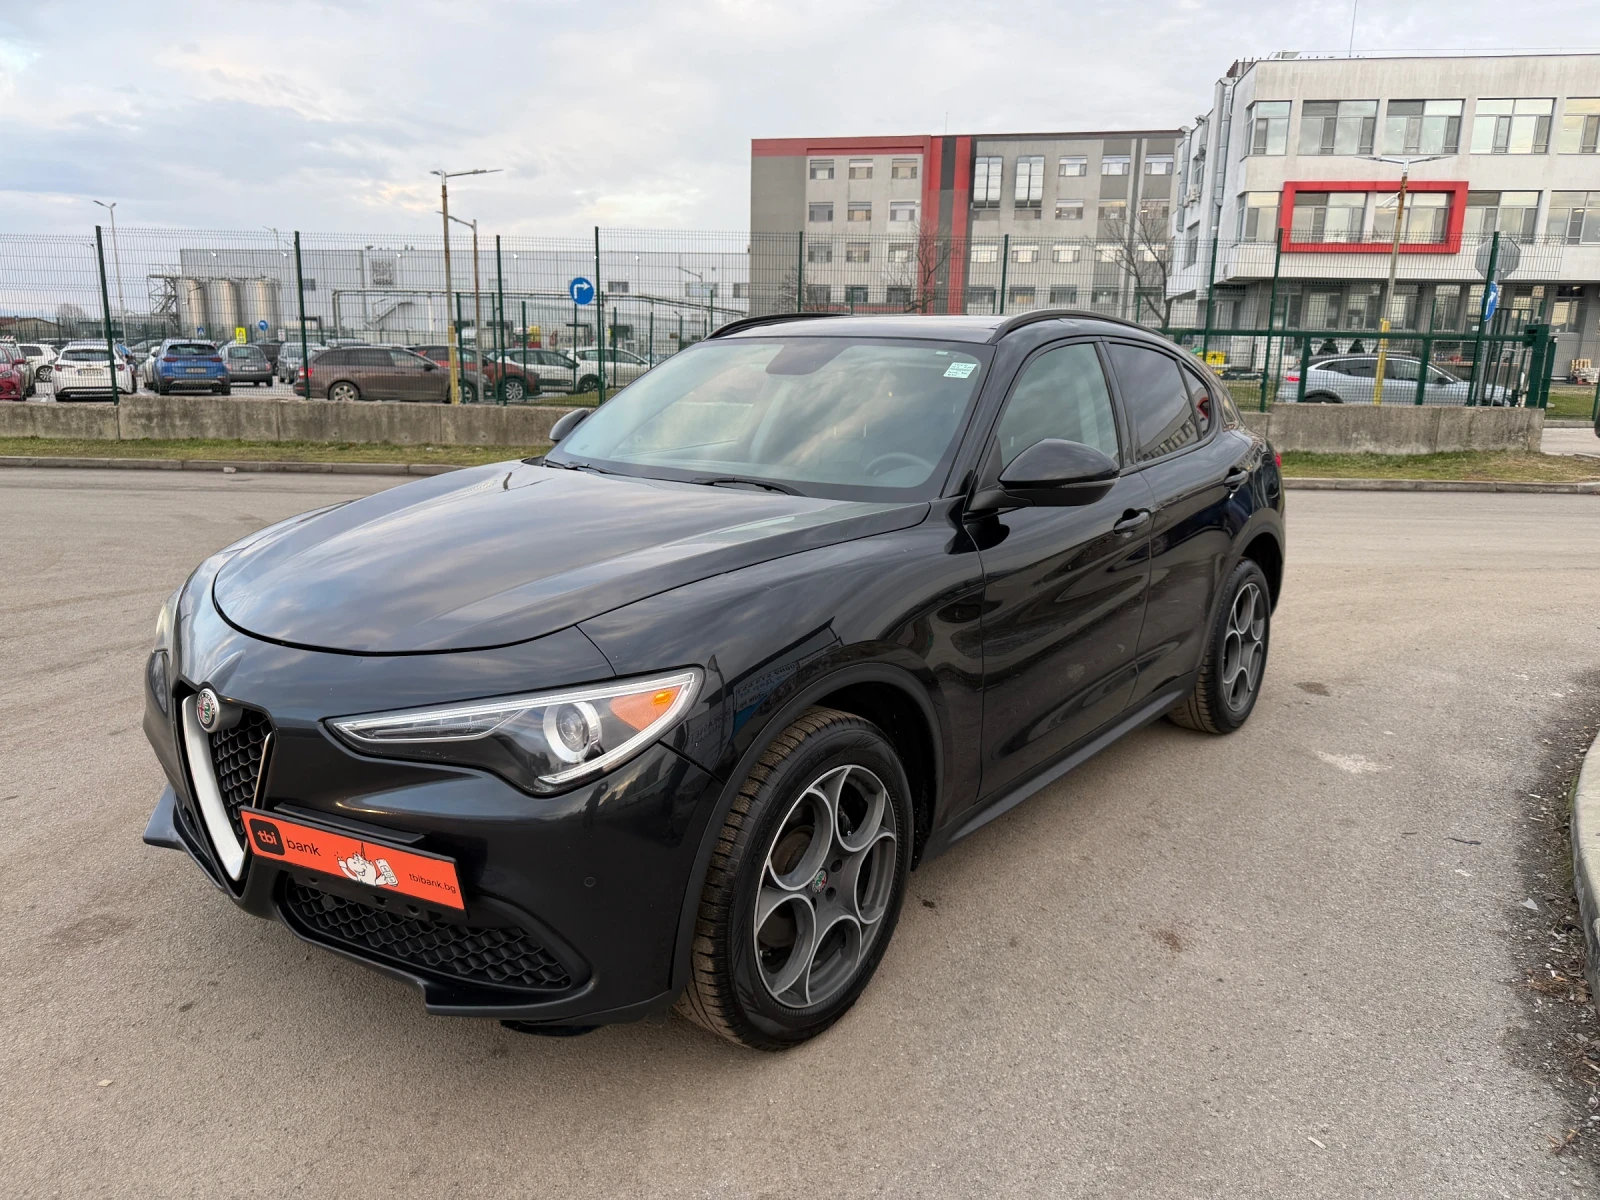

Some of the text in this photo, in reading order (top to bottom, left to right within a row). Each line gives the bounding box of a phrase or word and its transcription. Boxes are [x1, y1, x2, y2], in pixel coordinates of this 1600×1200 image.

[257, 830, 321, 856] tbi bank
[409, 873, 457, 894] tbibank.bg
